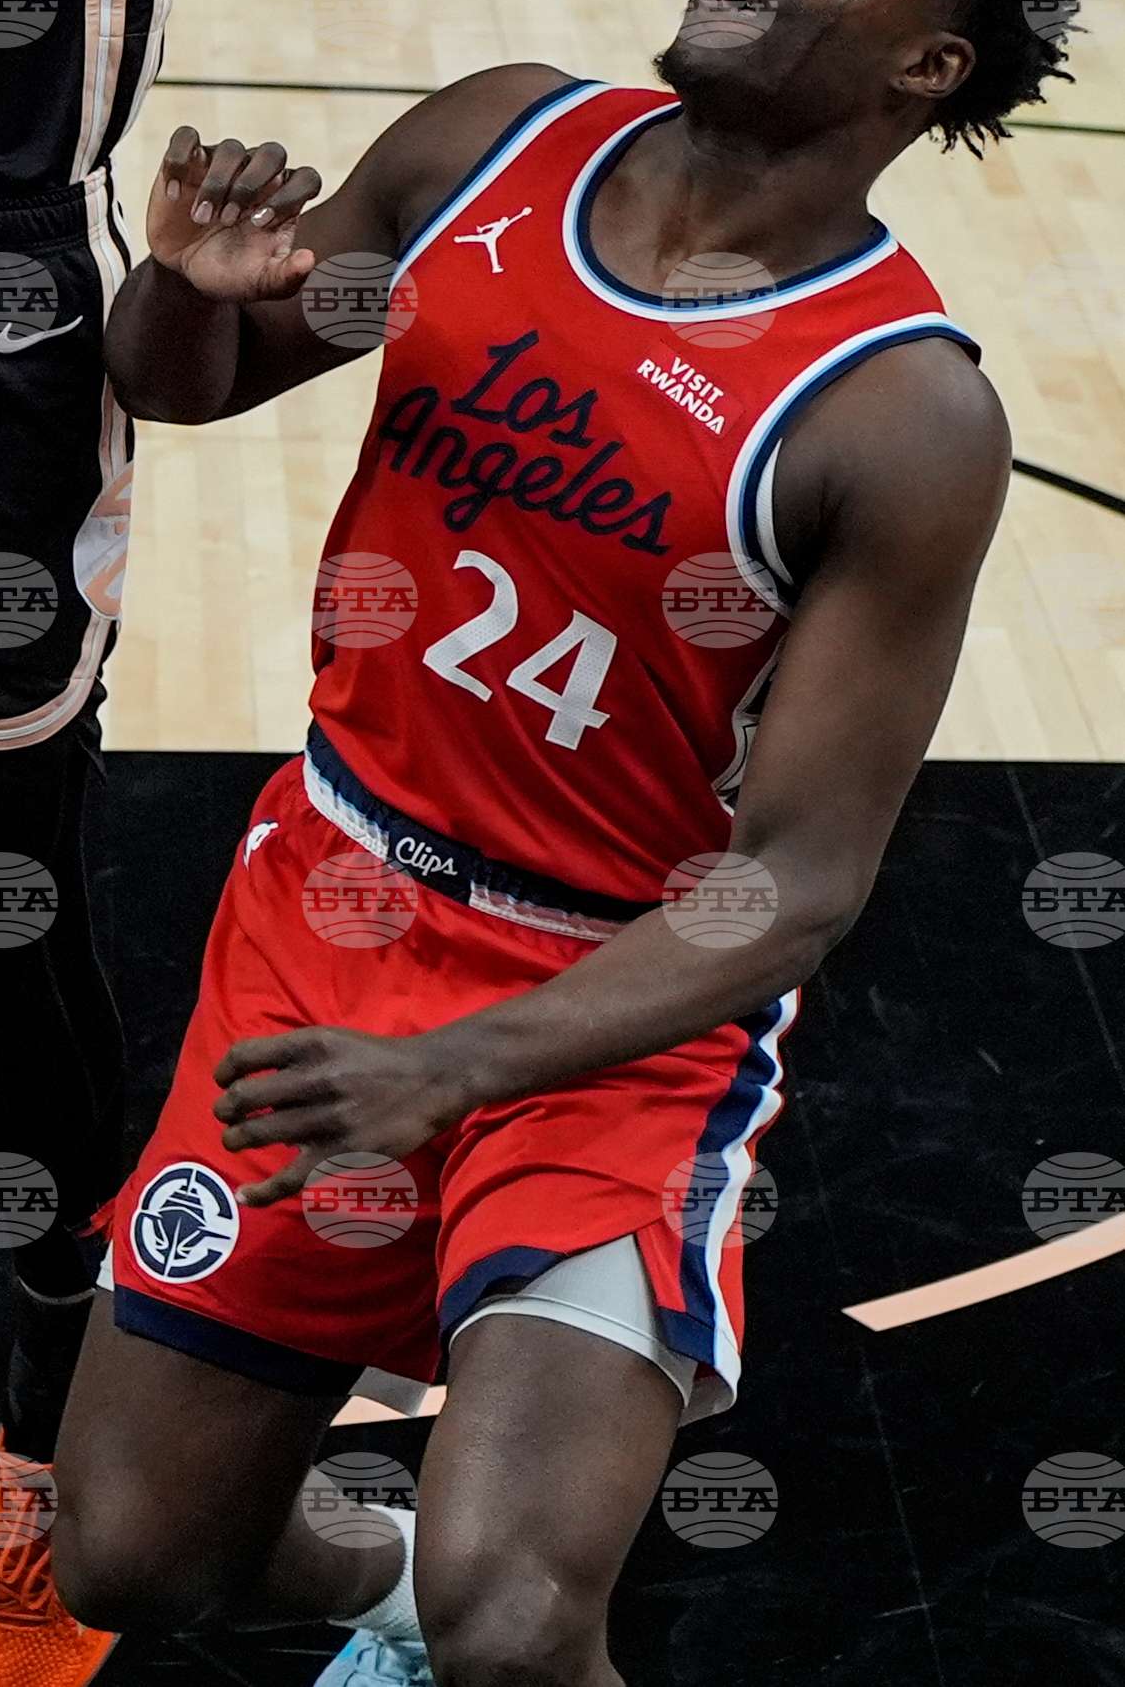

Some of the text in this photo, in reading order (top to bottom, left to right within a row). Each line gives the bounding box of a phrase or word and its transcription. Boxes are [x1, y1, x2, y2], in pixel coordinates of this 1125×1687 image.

[450, 329, 598, 449] Los
[637, 358, 725, 435] RWANDA
[671, 356, 725, 404] VISIT
[378, 386, 672, 556] Angeles
[422, 550, 617, 750] 24
[395, 836, 458, 876] Clips
